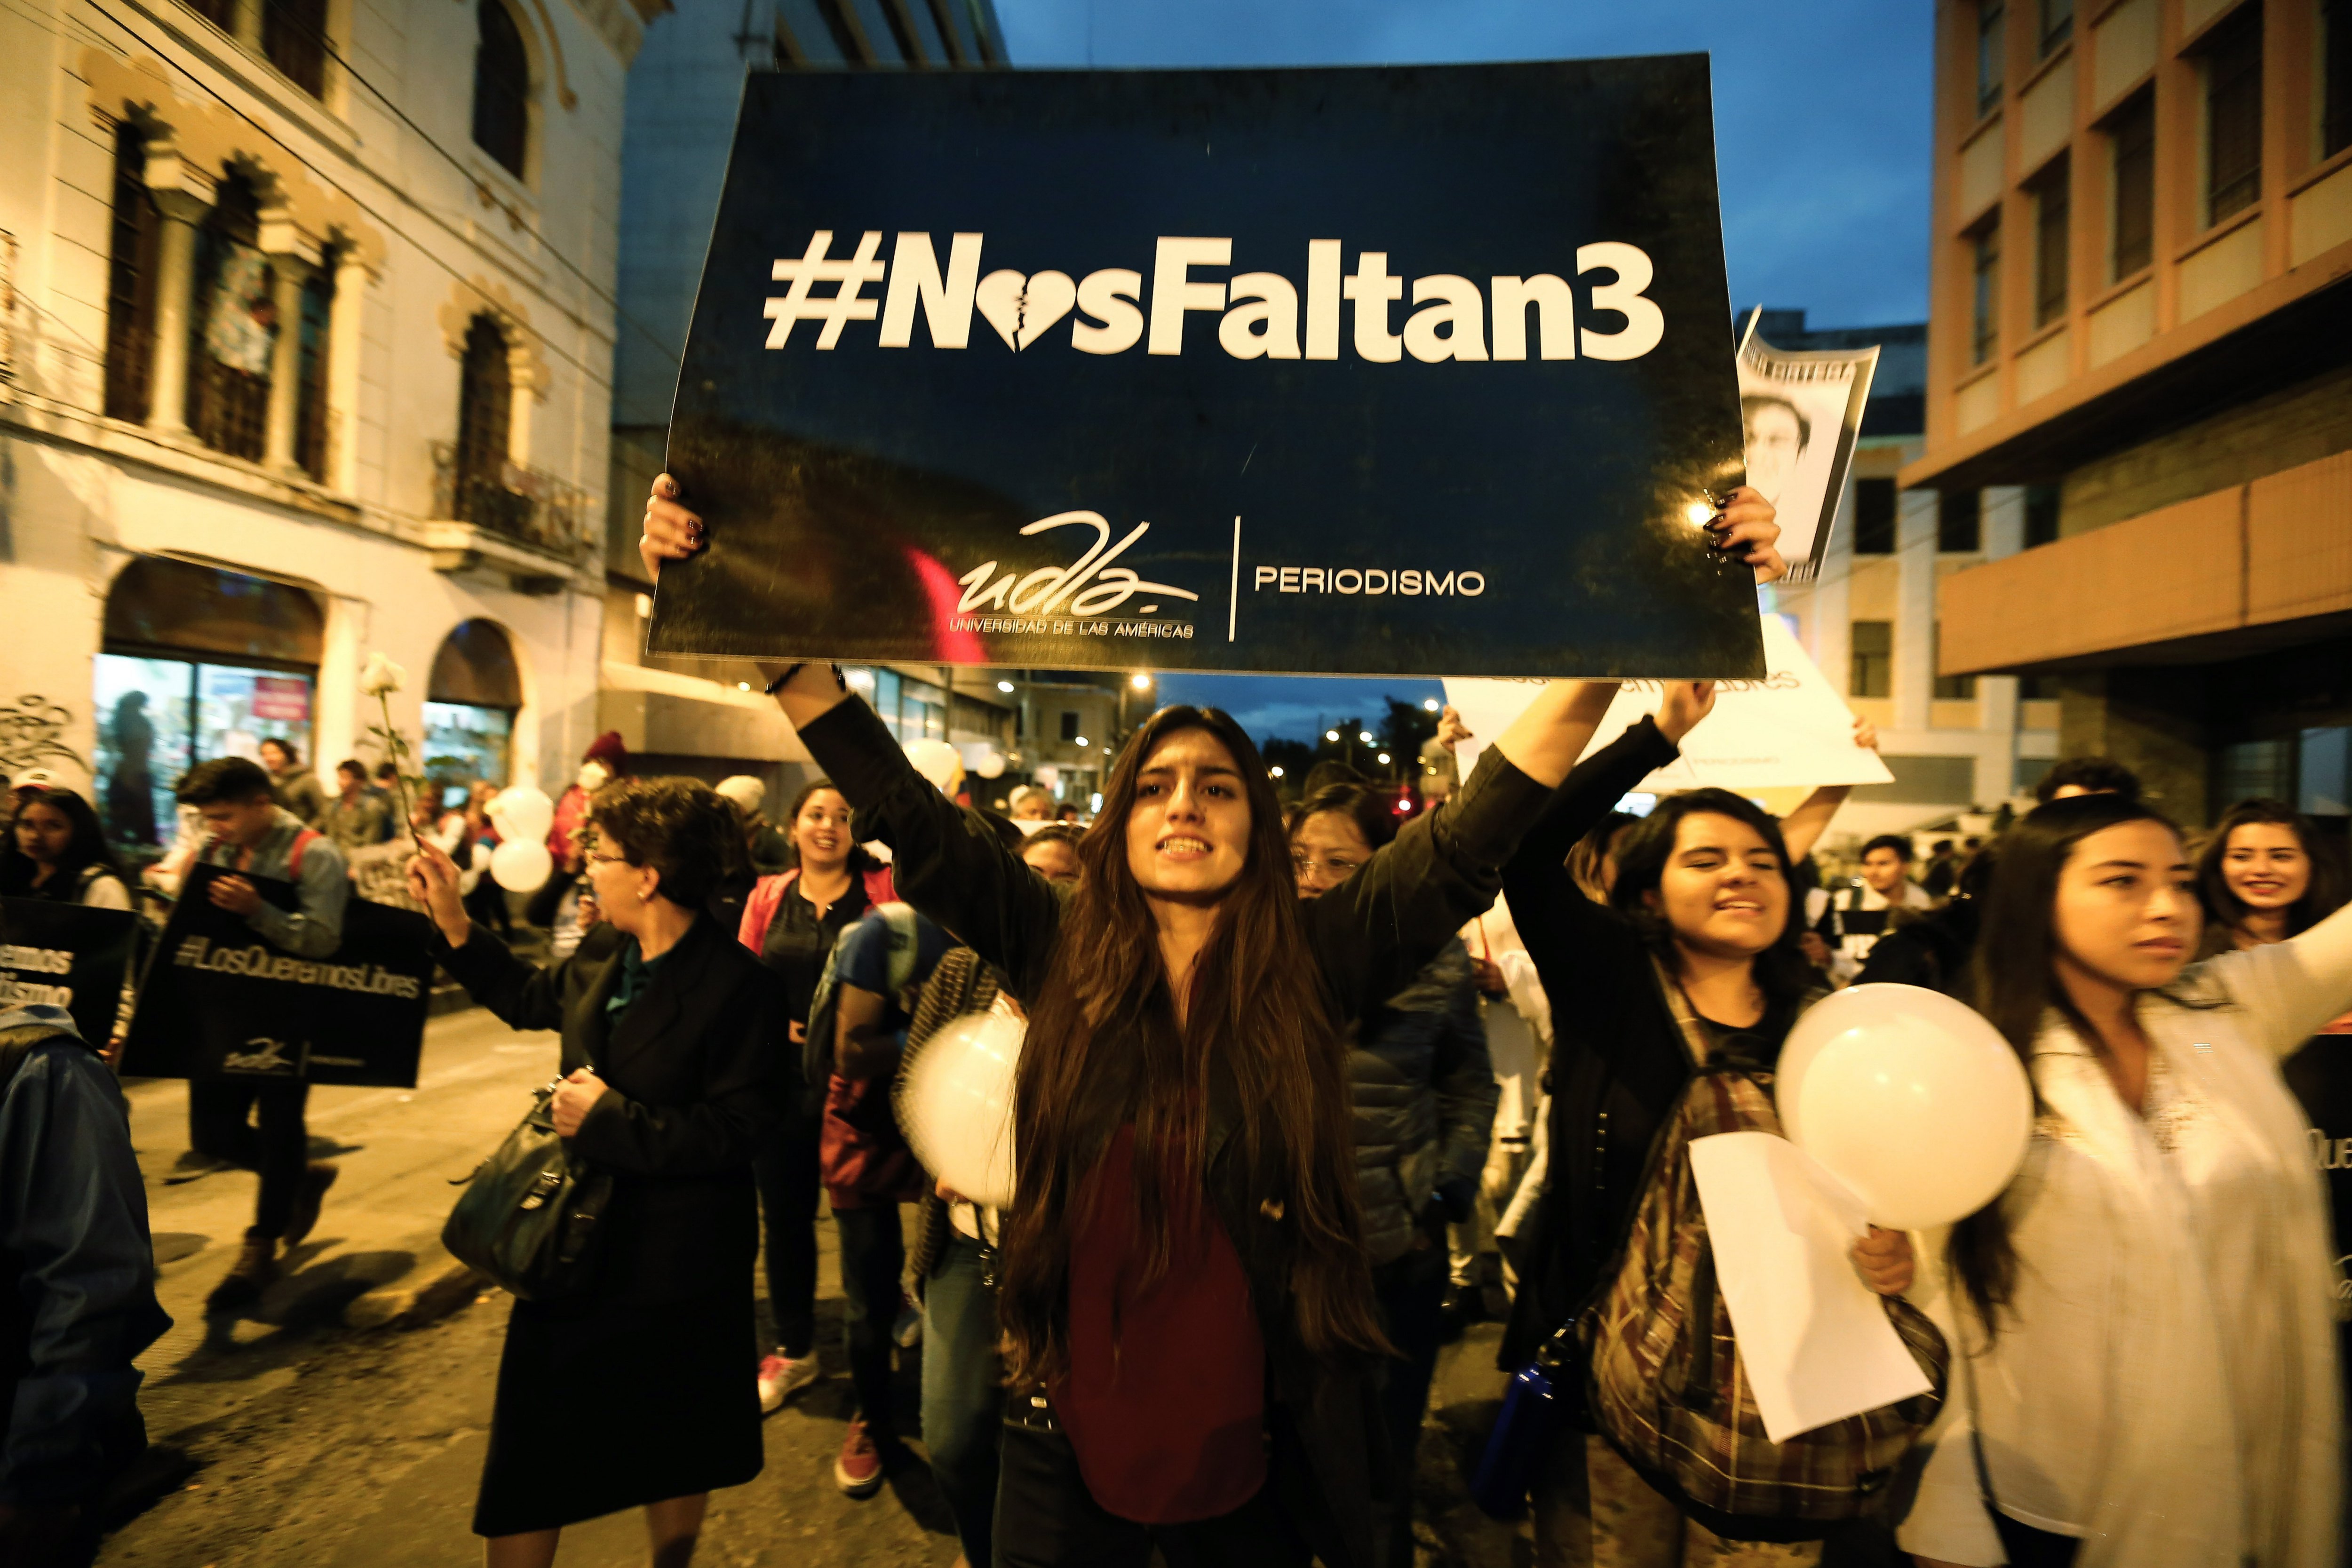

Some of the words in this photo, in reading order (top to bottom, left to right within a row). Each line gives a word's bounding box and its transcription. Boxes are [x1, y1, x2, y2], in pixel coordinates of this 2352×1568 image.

[1255, 565, 1485, 597] PERIODISMO
[948, 617, 1047, 635] UNIVERSIDAD
[1053, 620, 1075, 635] DE
[1079, 621, 1108, 636] LAS
[1113, 621, 1194, 639] AMÉRICAS
[173, 934, 421, 999] #LosQueremosLibres
